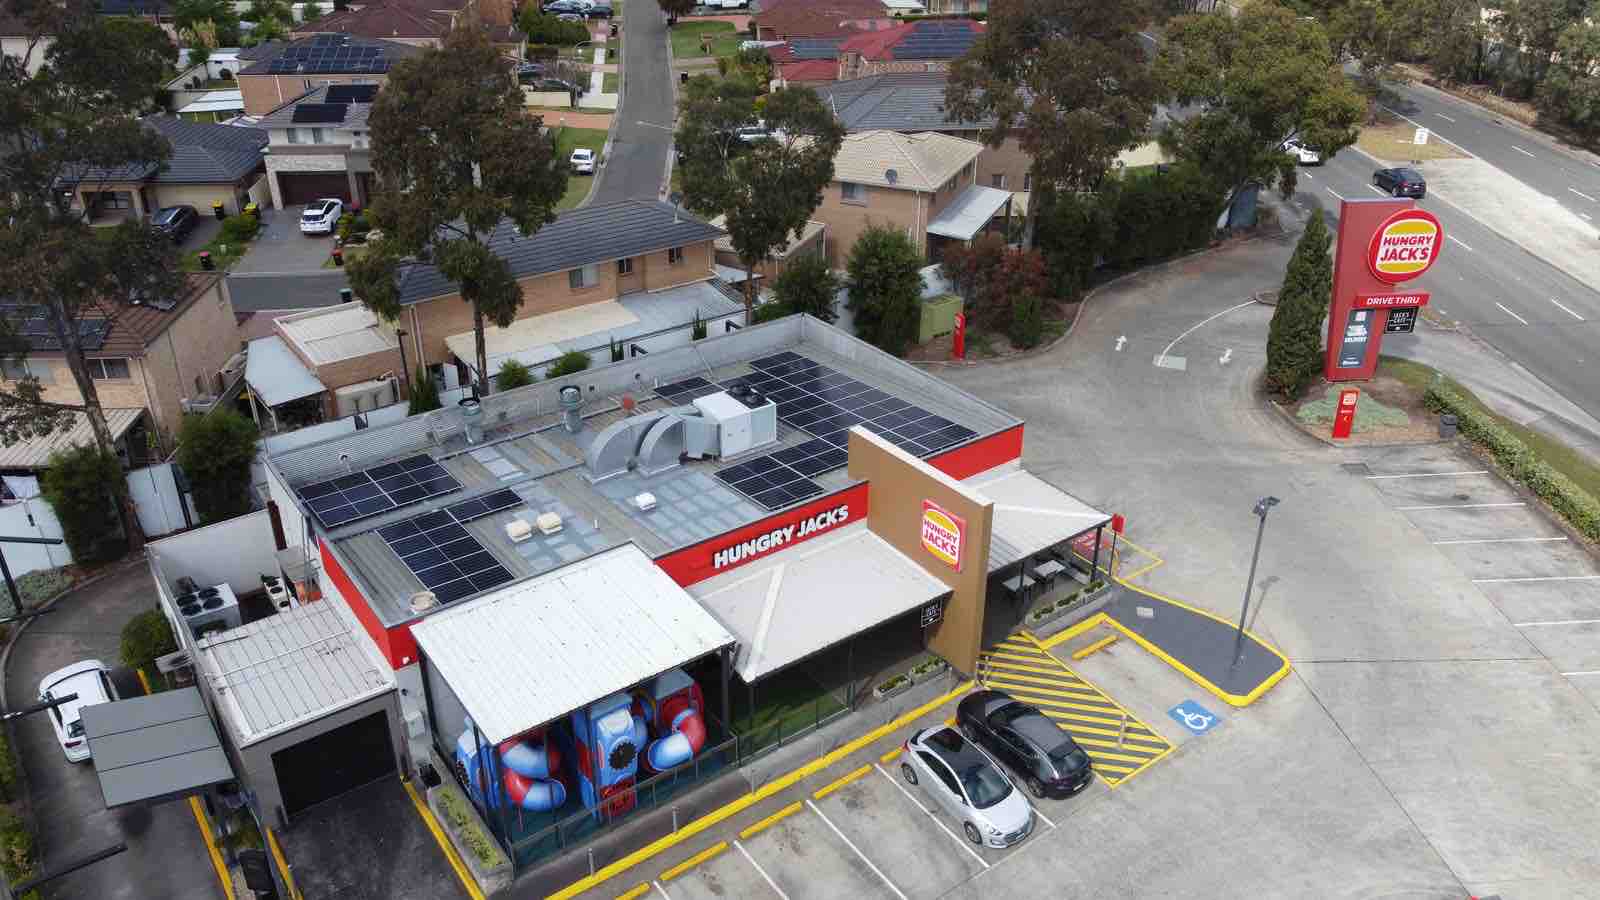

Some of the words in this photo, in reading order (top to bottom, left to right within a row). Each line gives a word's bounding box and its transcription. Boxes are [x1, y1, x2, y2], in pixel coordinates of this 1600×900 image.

[1383, 236, 1433, 246] HUNGRY
[1380, 247, 1430, 261] JACK'S
[1366, 297, 1393, 305] DRIVE
[1396, 296, 1420, 304] THRU
[923, 519, 958, 544] HUNGRY
[713, 525, 794, 569] HUNGRY
